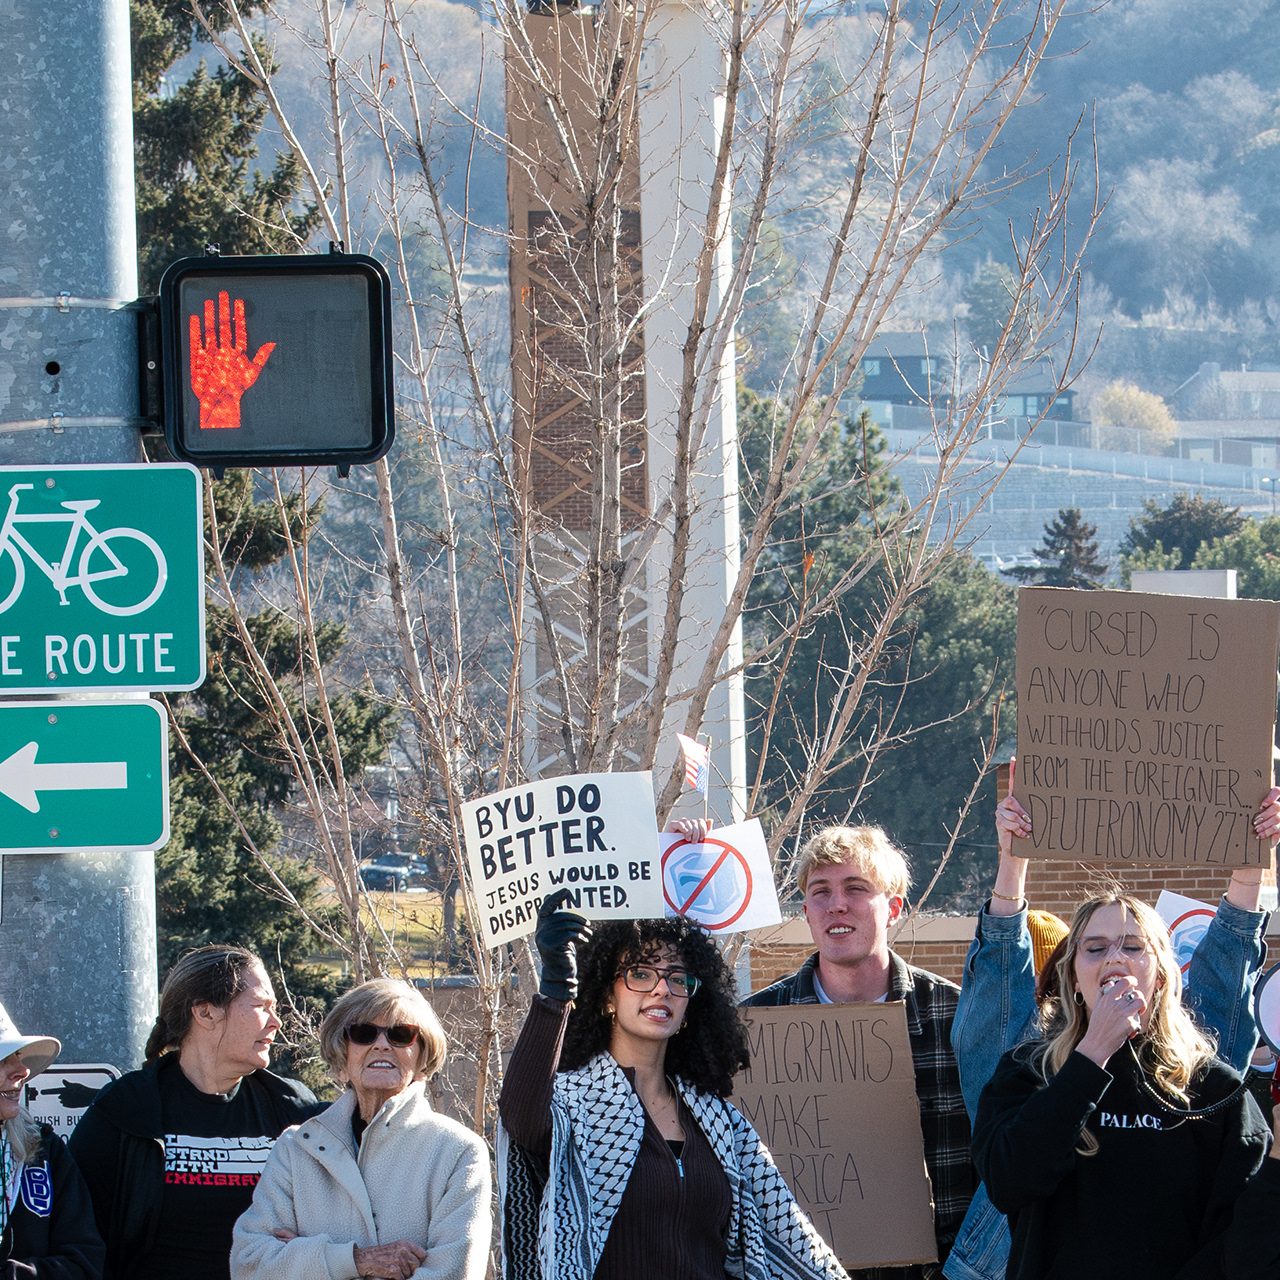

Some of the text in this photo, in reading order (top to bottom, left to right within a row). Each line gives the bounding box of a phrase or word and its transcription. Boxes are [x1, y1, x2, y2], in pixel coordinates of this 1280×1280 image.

[45, 632, 176, 675] ROUTE
[1187, 613, 1220, 661] IS
[1028, 667, 1205, 713] ANYONE WHO
[1026, 714, 1226, 763] WITHHOLDS JUSTICE
[1023, 755, 1068, 789] FROM
[1081, 757, 1113, 793] THE
[475, 783, 601, 839] BYU, DO
[1028, 794, 1206, 861] DEUTERONOMY
[479, 815, 616, 880] BETTER.
[486, 861, 651, 910] JESUS WOULD BE
[488, 885, 630, 935] DISAPPNTED.
[740, 1094, 831, 1148] MAKE
[1100, 1112, 1163, 1130] PALACE
[165, 1148, 229, 1161] STAND
[165, 1161, 219, 1173] WITH
[773, 1152, 864, 1204] RICA
